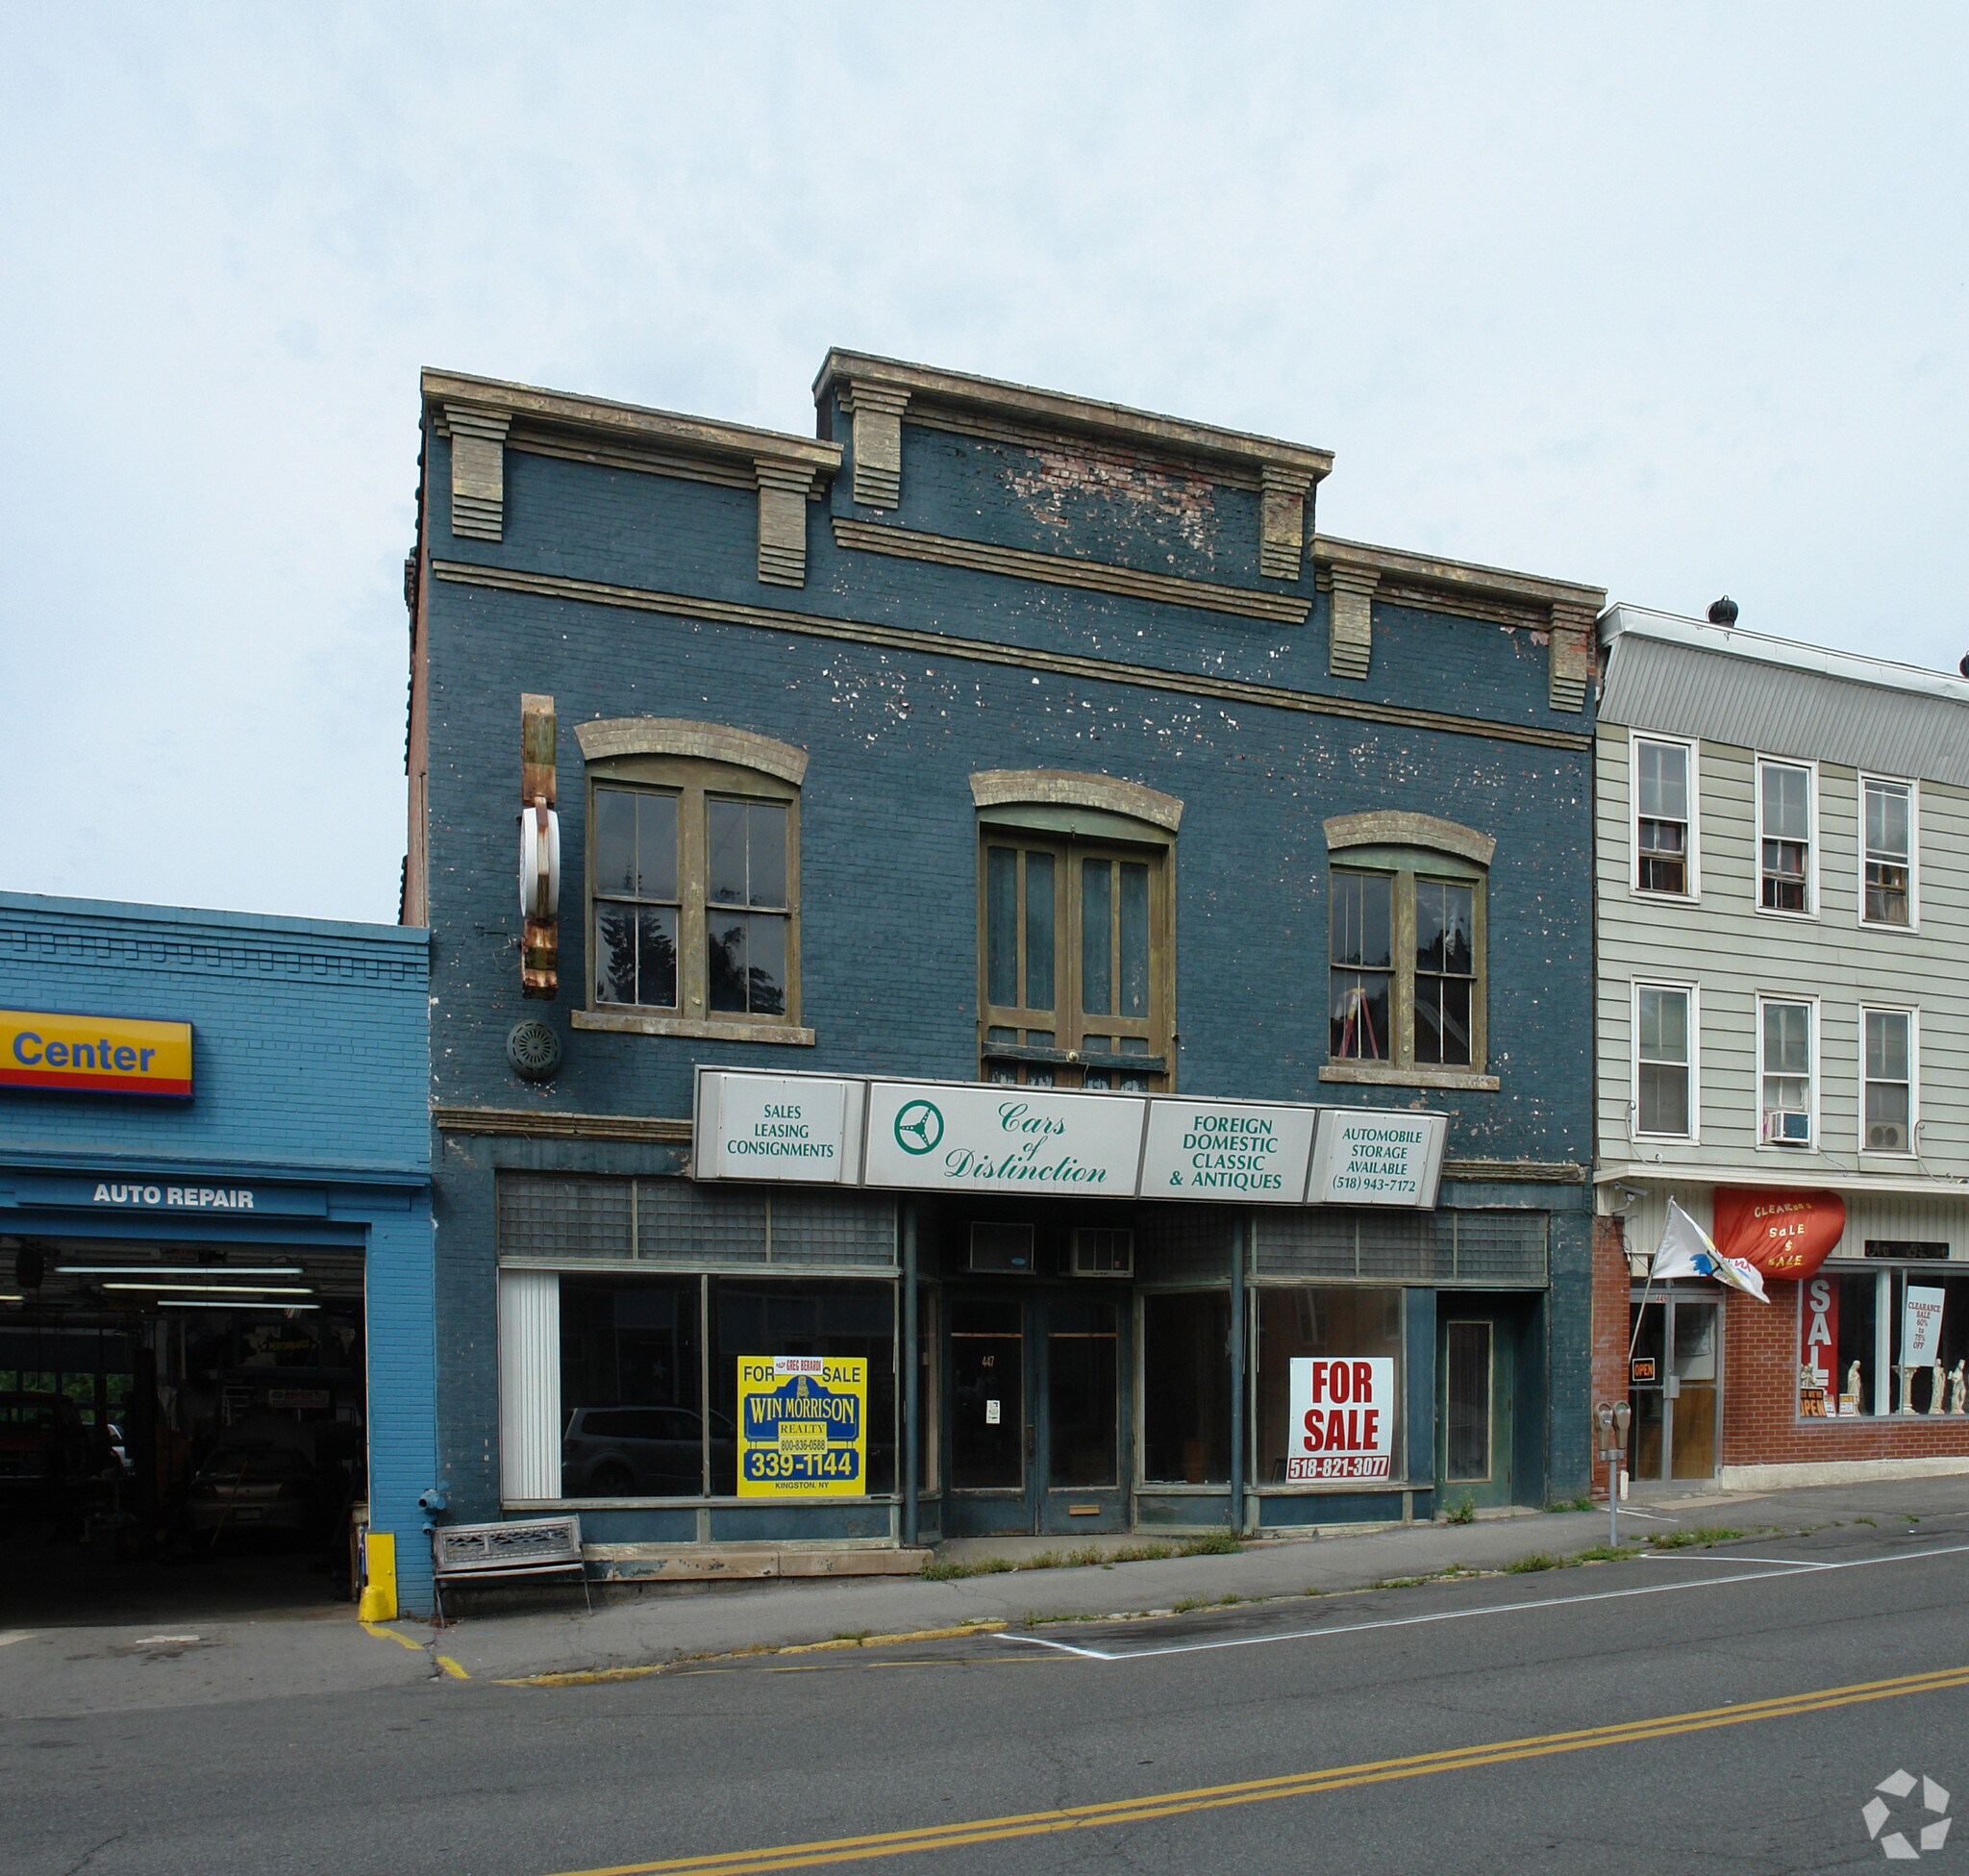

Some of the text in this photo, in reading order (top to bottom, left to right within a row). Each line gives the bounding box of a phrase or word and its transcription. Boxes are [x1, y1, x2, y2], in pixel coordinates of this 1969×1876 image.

[13, 1031, 156, 1072] Center
[764, 1104, 802, 1119] SALES
[998, 1102, 1066, 1135] Cars
[755, 1123, 810, 1138] LEASING
[1193, 1116, 1273, 1135] FOREIGN
[1183, 1134, 1278, 1153] DOMESTIC
[1342, 1128, 1423, 1143] AUTOMOBILE
[728, 1139, 834, 1158] CONSIGNMENTS
[1023, 1136, 1040, 1161] of
[1351, 1144, 1408, 1159] STORAGE
[944, 1148, 1107, 1184] Distinction
[1192, 1153, 1265, 1170] CLASSIC
[1346, 1161, 1408, 1175] AVAILABLE
[1169, 1170, 1283, 1191] & ANTIQUES
[1333, 1174, 1416, 1192] (518) 943-7172
[93, 1184, 254, 1208] AUTO REPAIR
[1908, 1302, 1941, 1313] CLEARANCE
[982, 1355, 995, 1367] 447
[1634, 1363, 1653, 1377] OPEN
[744, 1365, 860, 1382] FOR SALE
[1312, 1361, 1372, 1404] FOR
[750, 1396, 855, 1423] WIN MORRISON
[780, 1424, 825, 1434] REALTY
[1303, 1409, 1379, 1452] SALE
[751, 1452, 852, 1476] 339-1144
[1290, 1457, 1387, 1478] 518-821-3077
